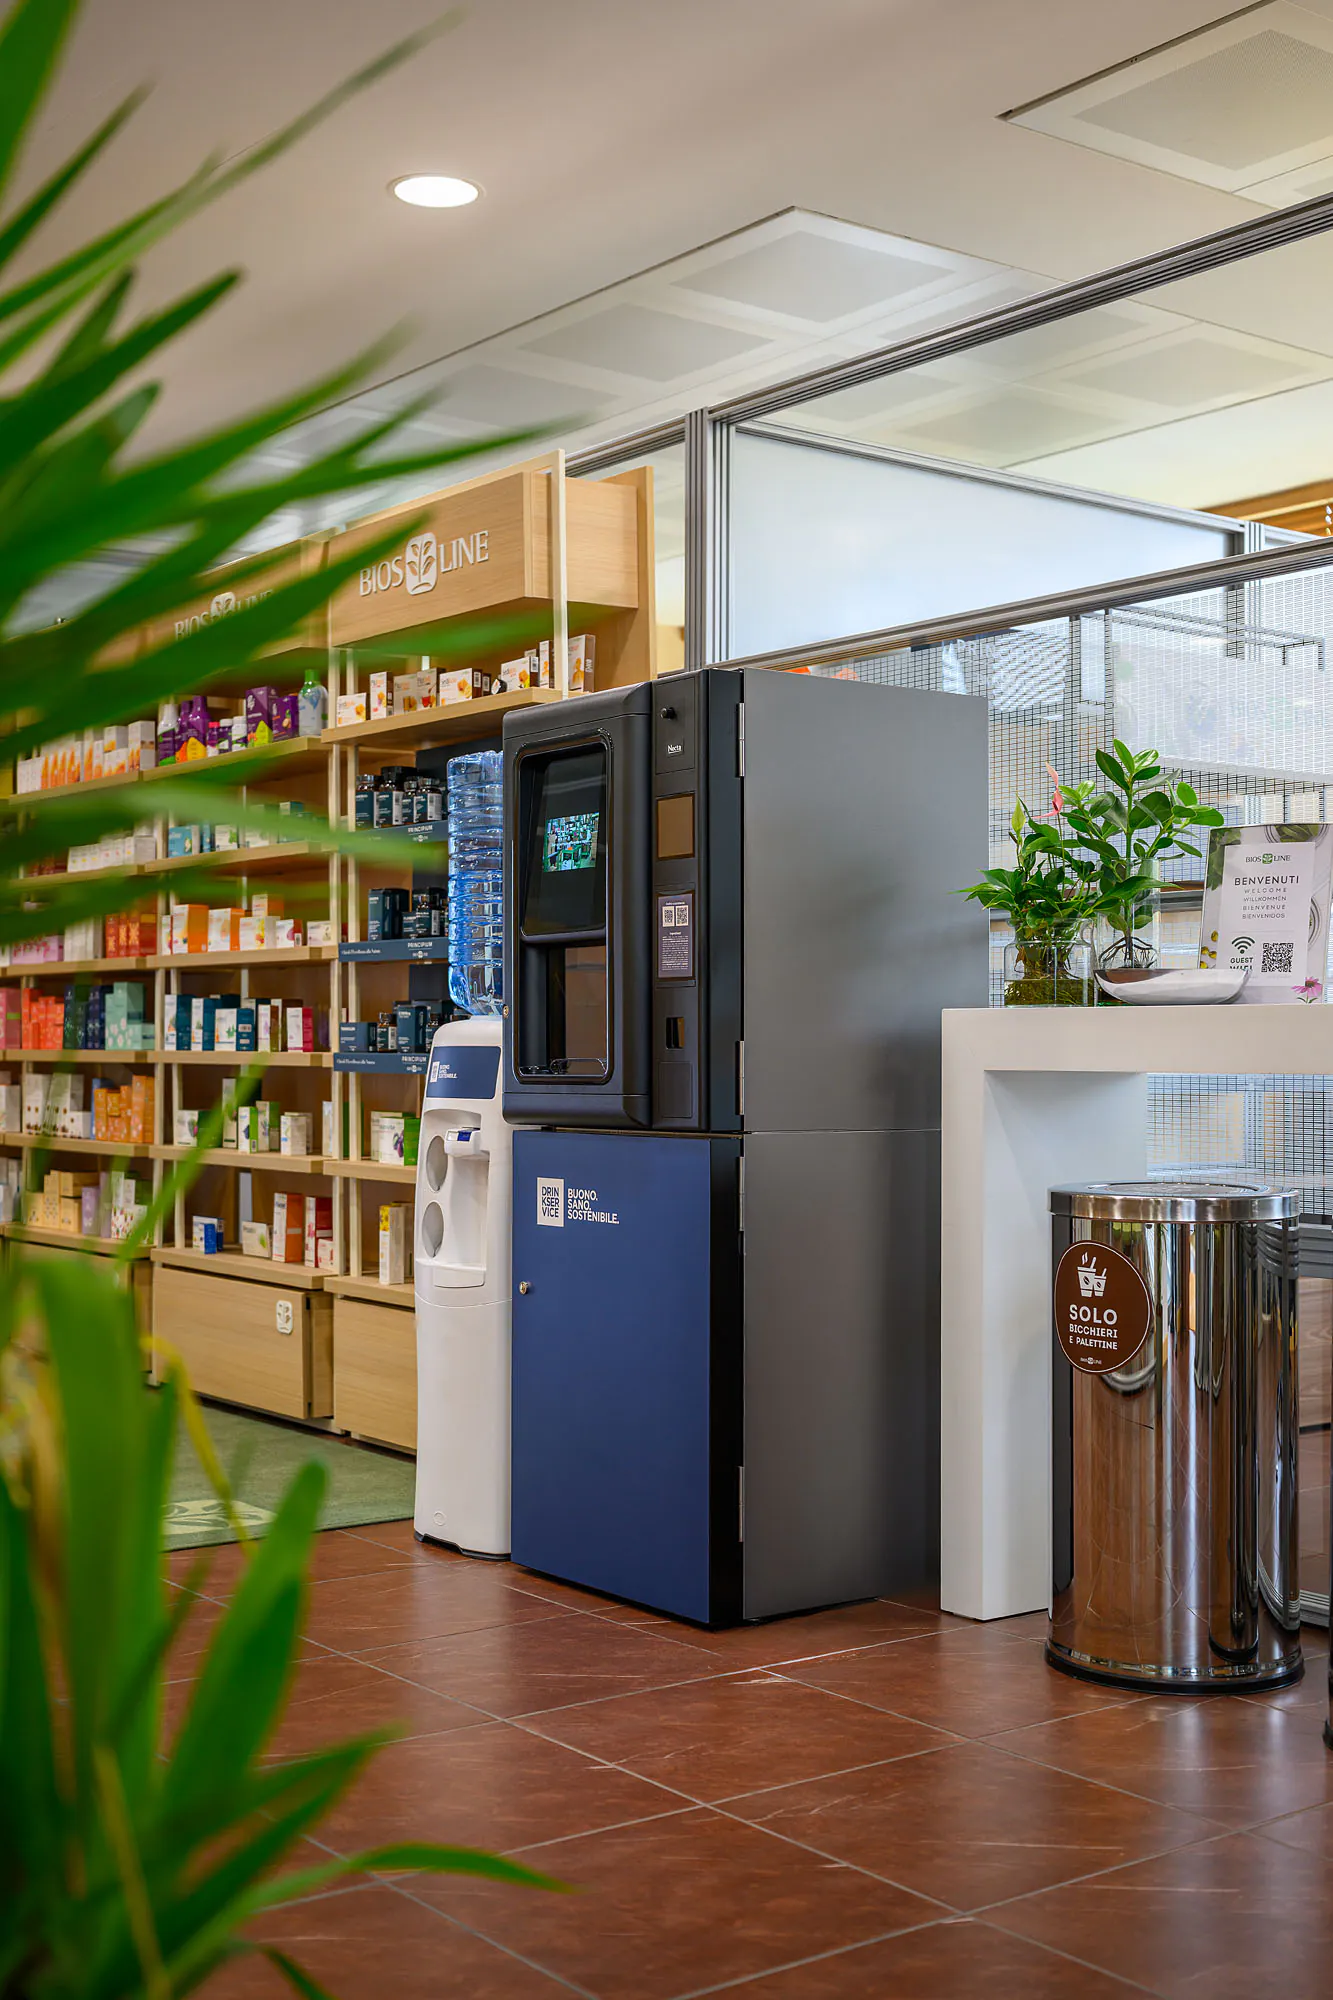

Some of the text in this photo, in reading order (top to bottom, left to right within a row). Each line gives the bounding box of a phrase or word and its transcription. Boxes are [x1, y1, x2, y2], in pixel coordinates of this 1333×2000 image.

[360, 529, 490, 597] BIOS LINE
[1245, 854, 1291, 863] BIOS LINE
[1235, 876, 1299, 885] BENVENUTI
[541, 1186, 559, 1197] DRIN
[567, 1188, 598, 1201] BUONO.
[541, 1196, 560, 1208] KSER
[567, 1198, 592, 1211] SANO.
[541, 1206, 559, 1218] VICE
[567, 1209, 620, 1225] SOSTENIBILE.
[1069, 1303, 1118, 1326] SOLO
[1069, 1323, 1118, 1339] BICCHIERI
[1069, 1335, 1118, 1350] E PALETTINE
